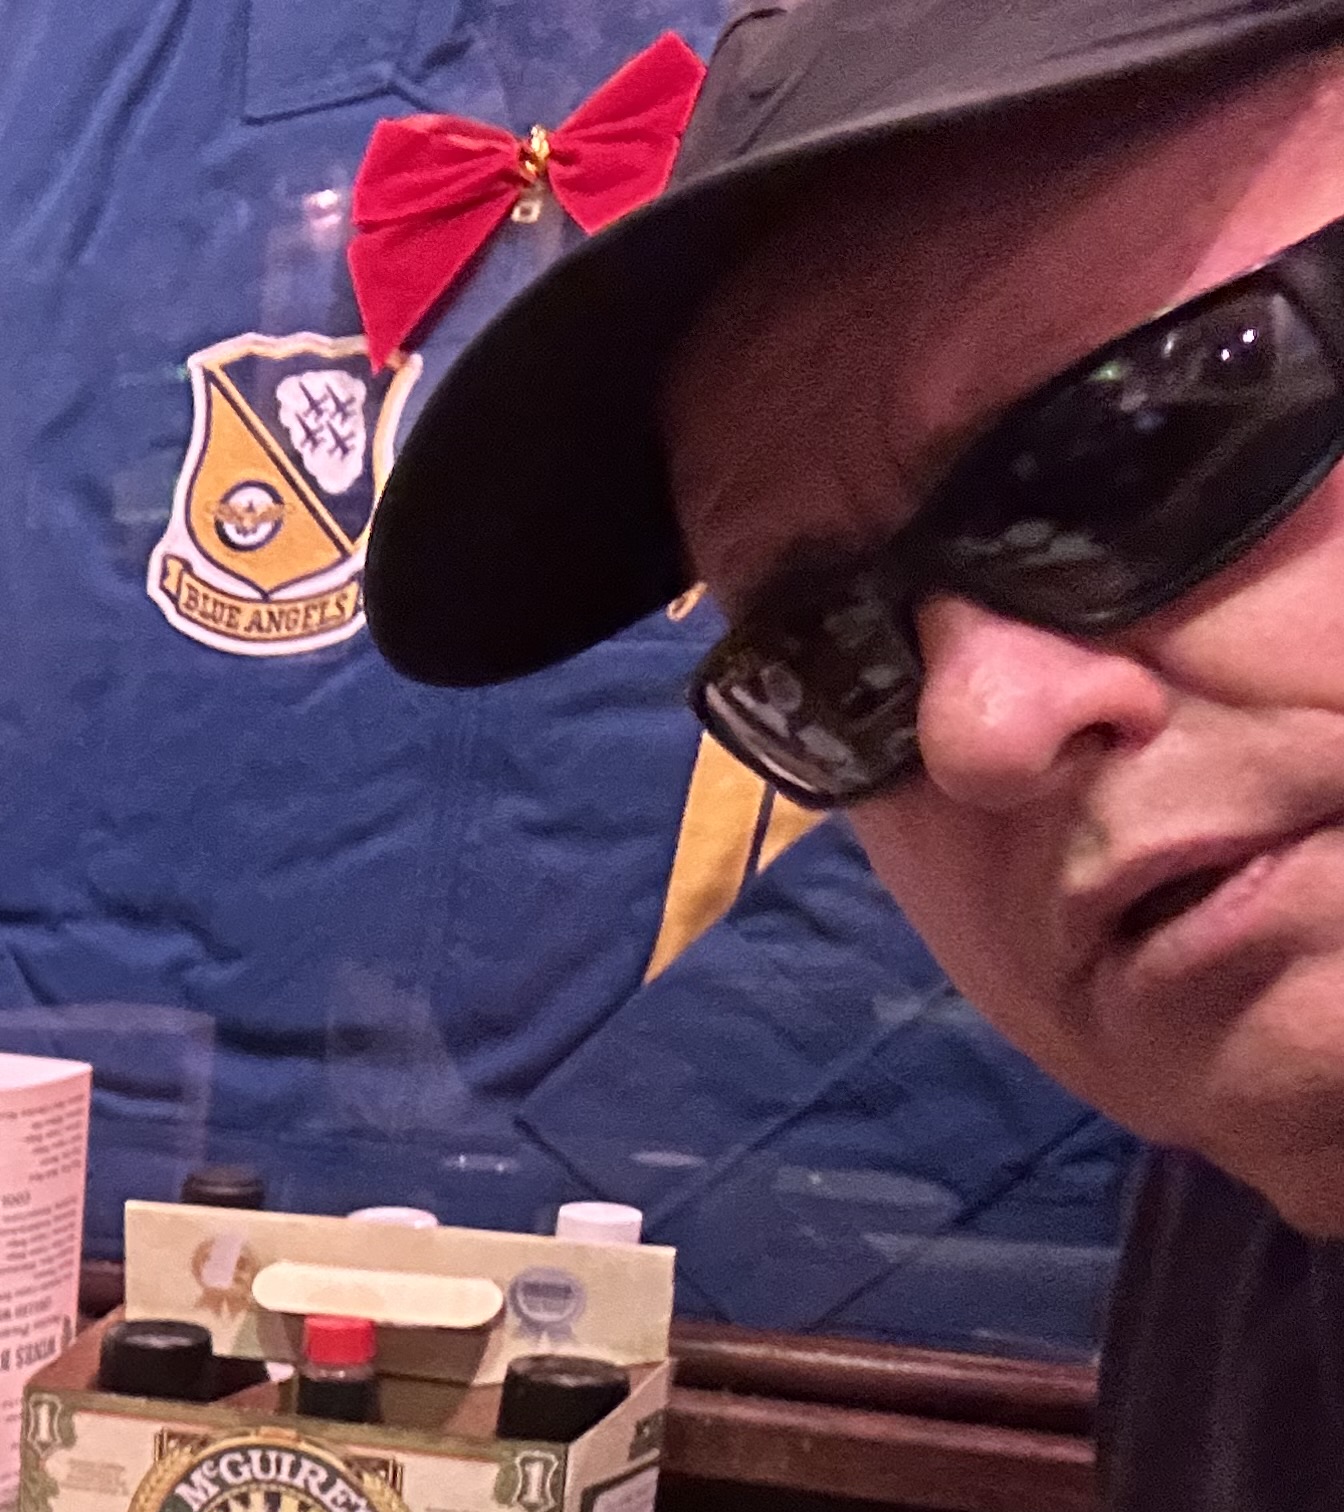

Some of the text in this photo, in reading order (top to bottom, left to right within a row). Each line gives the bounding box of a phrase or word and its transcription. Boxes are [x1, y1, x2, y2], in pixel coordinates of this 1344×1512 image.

[184, 584, 348, 632] BLUE ANGELS
[524, 1461, 543, 1502] 1
